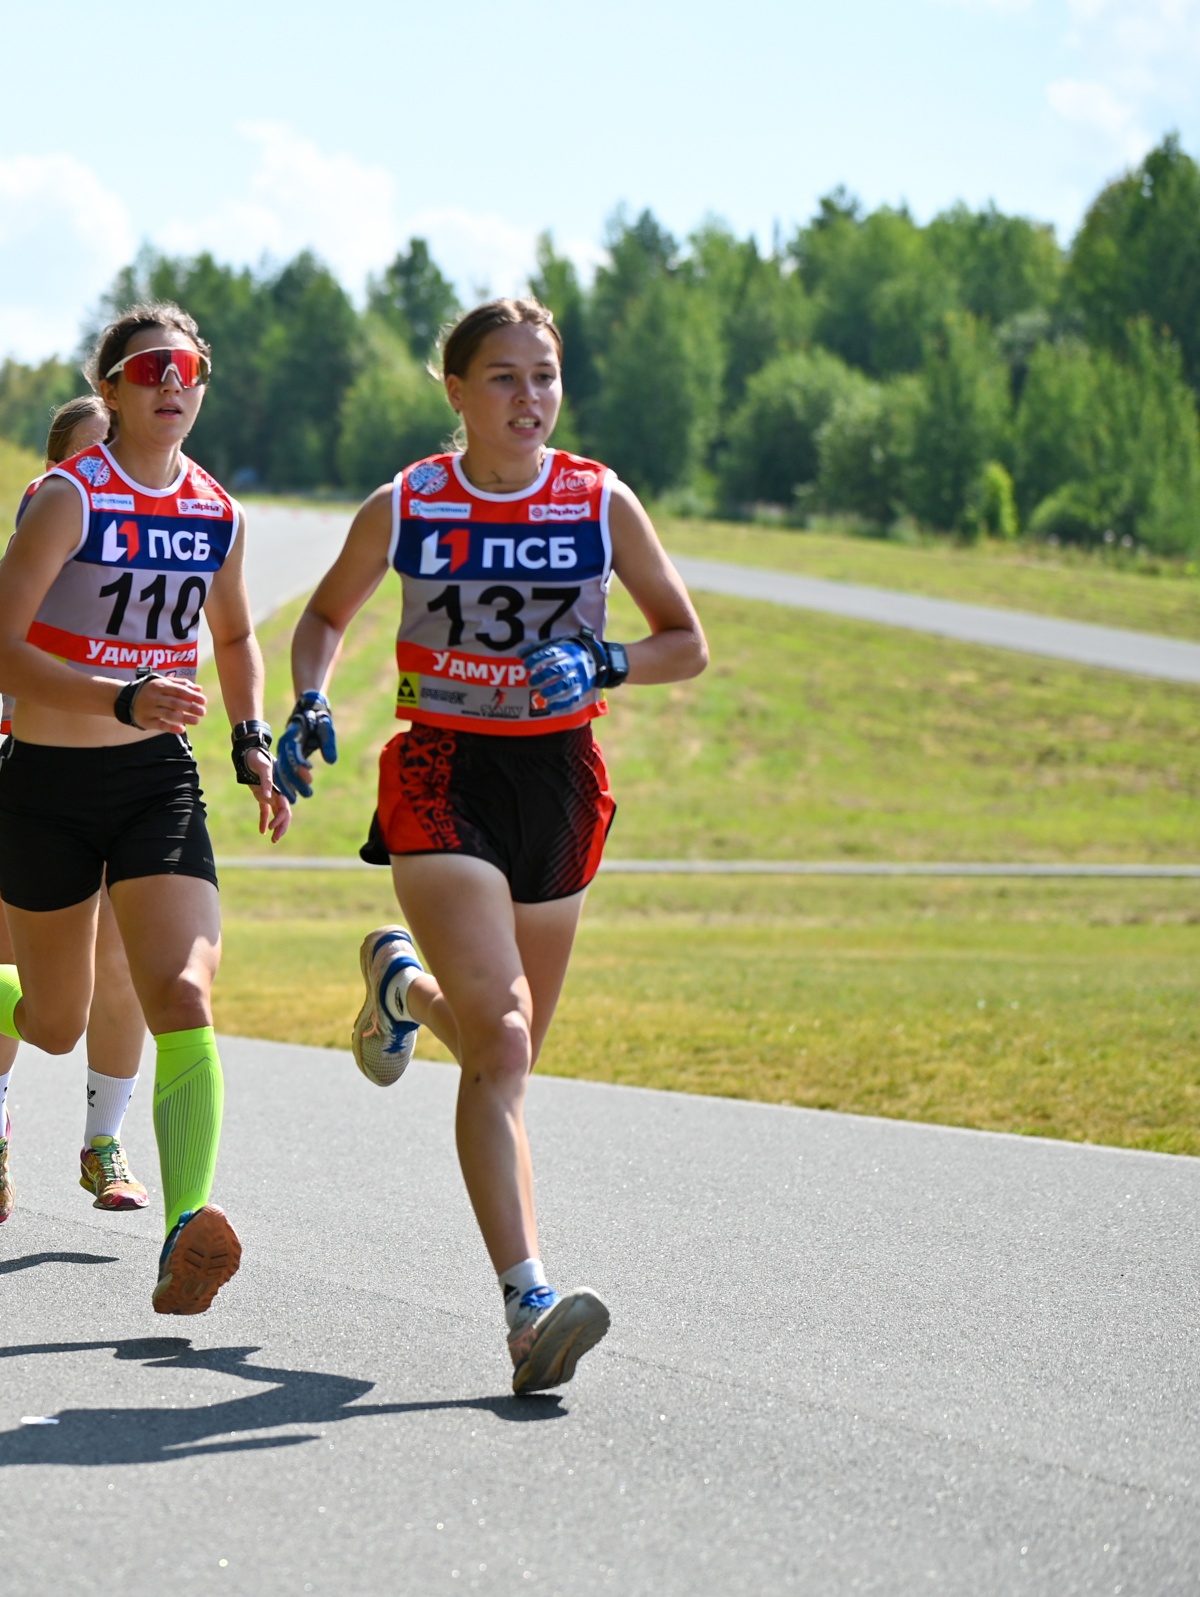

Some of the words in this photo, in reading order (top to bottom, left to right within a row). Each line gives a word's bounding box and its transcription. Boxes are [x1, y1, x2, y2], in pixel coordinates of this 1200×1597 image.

[148, 529, 211, 561] ПСБ
[482, 537, 578, 569] ПСБ
[99, 572, 207, 640] 110
[427, 585, 582, 652] 137
[86, 640, 196, 669] Удмуртия
[432, 651, 528, 686] Удмур
